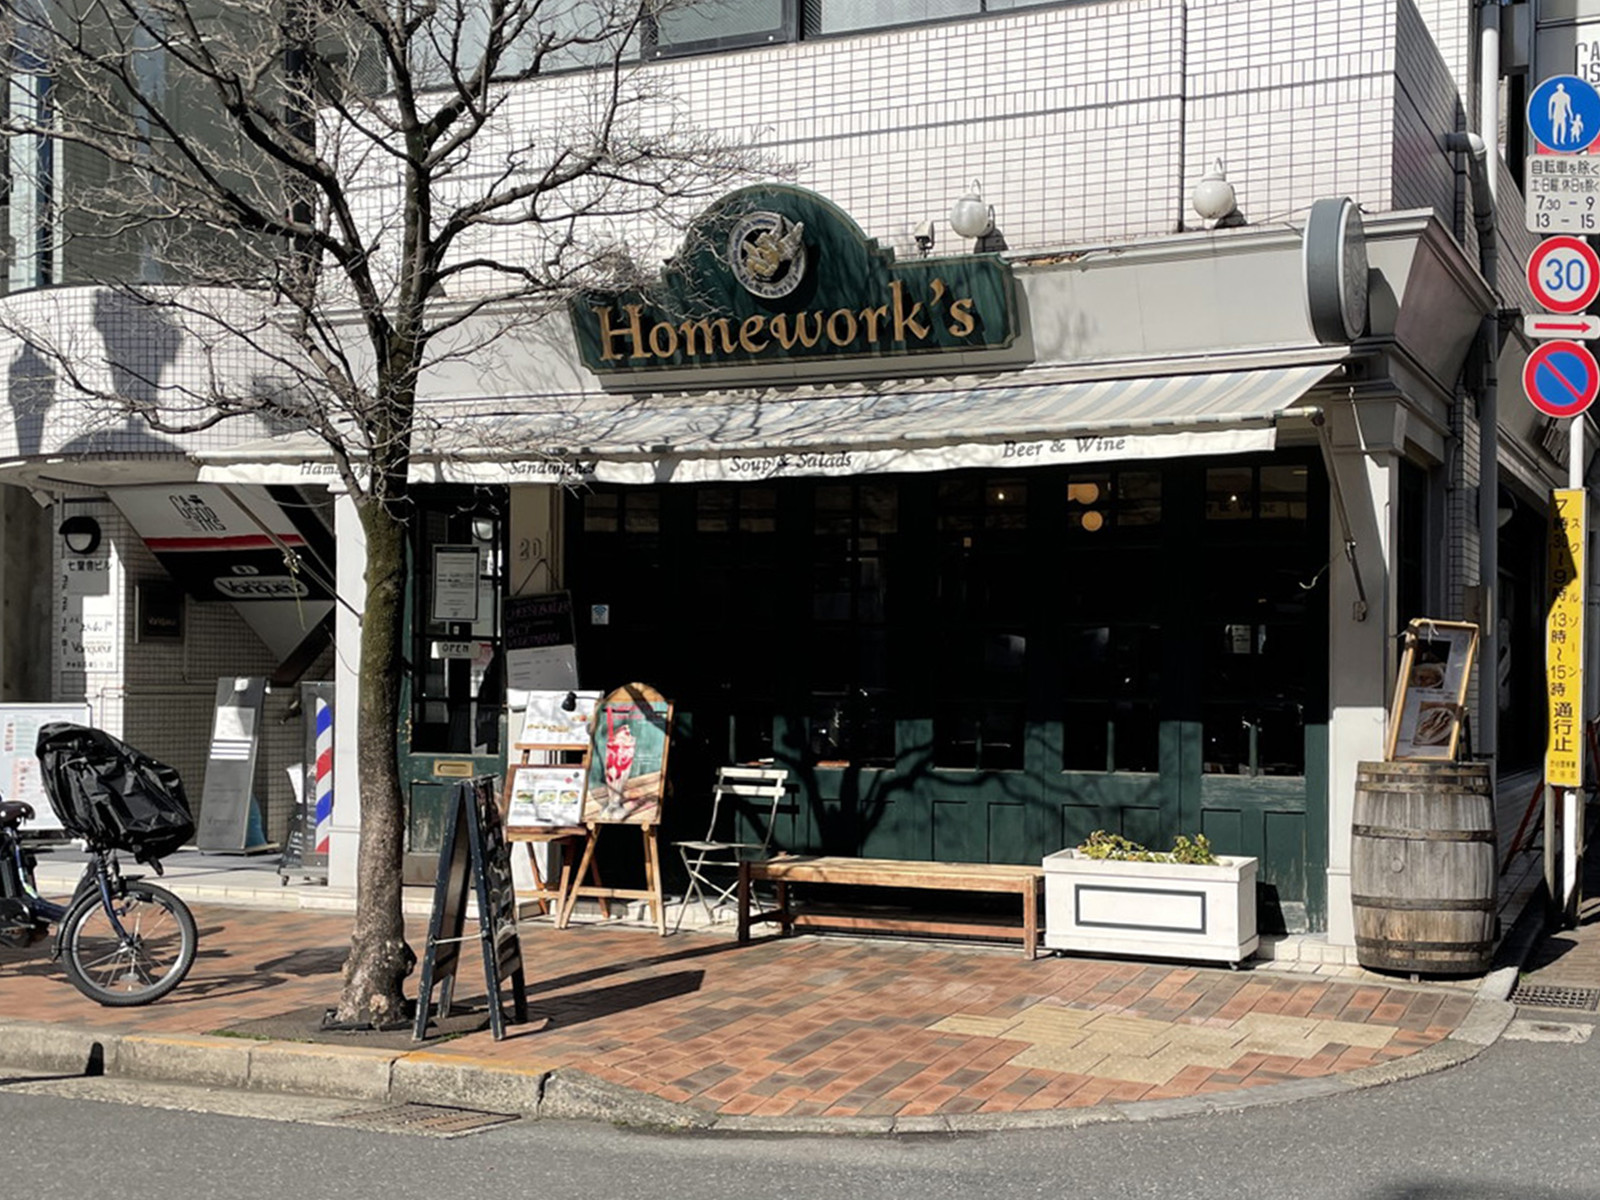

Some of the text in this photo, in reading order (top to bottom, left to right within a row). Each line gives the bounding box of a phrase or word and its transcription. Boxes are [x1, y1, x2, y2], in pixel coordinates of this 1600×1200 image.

[1531, 160, 1599, 175] 自転車を除く
[1586, 196, 1595, 211] 9
[1536, 213, 1550, 228] 13
[1581, 214, 1595, 229] 15
[1545, 258, 1585, 291] 30
[592, 279, 976, 361] Homework's
[1002, 437, 1126, 459] Beer & Wine
[509, 460, 597, 475] Sandwiches
[729, 455, 772, 475] Soup
[796, 451, 853, 469] Salads
[520, 538, 541, 560] 20
[442, 643, 469, 653] OPEN
